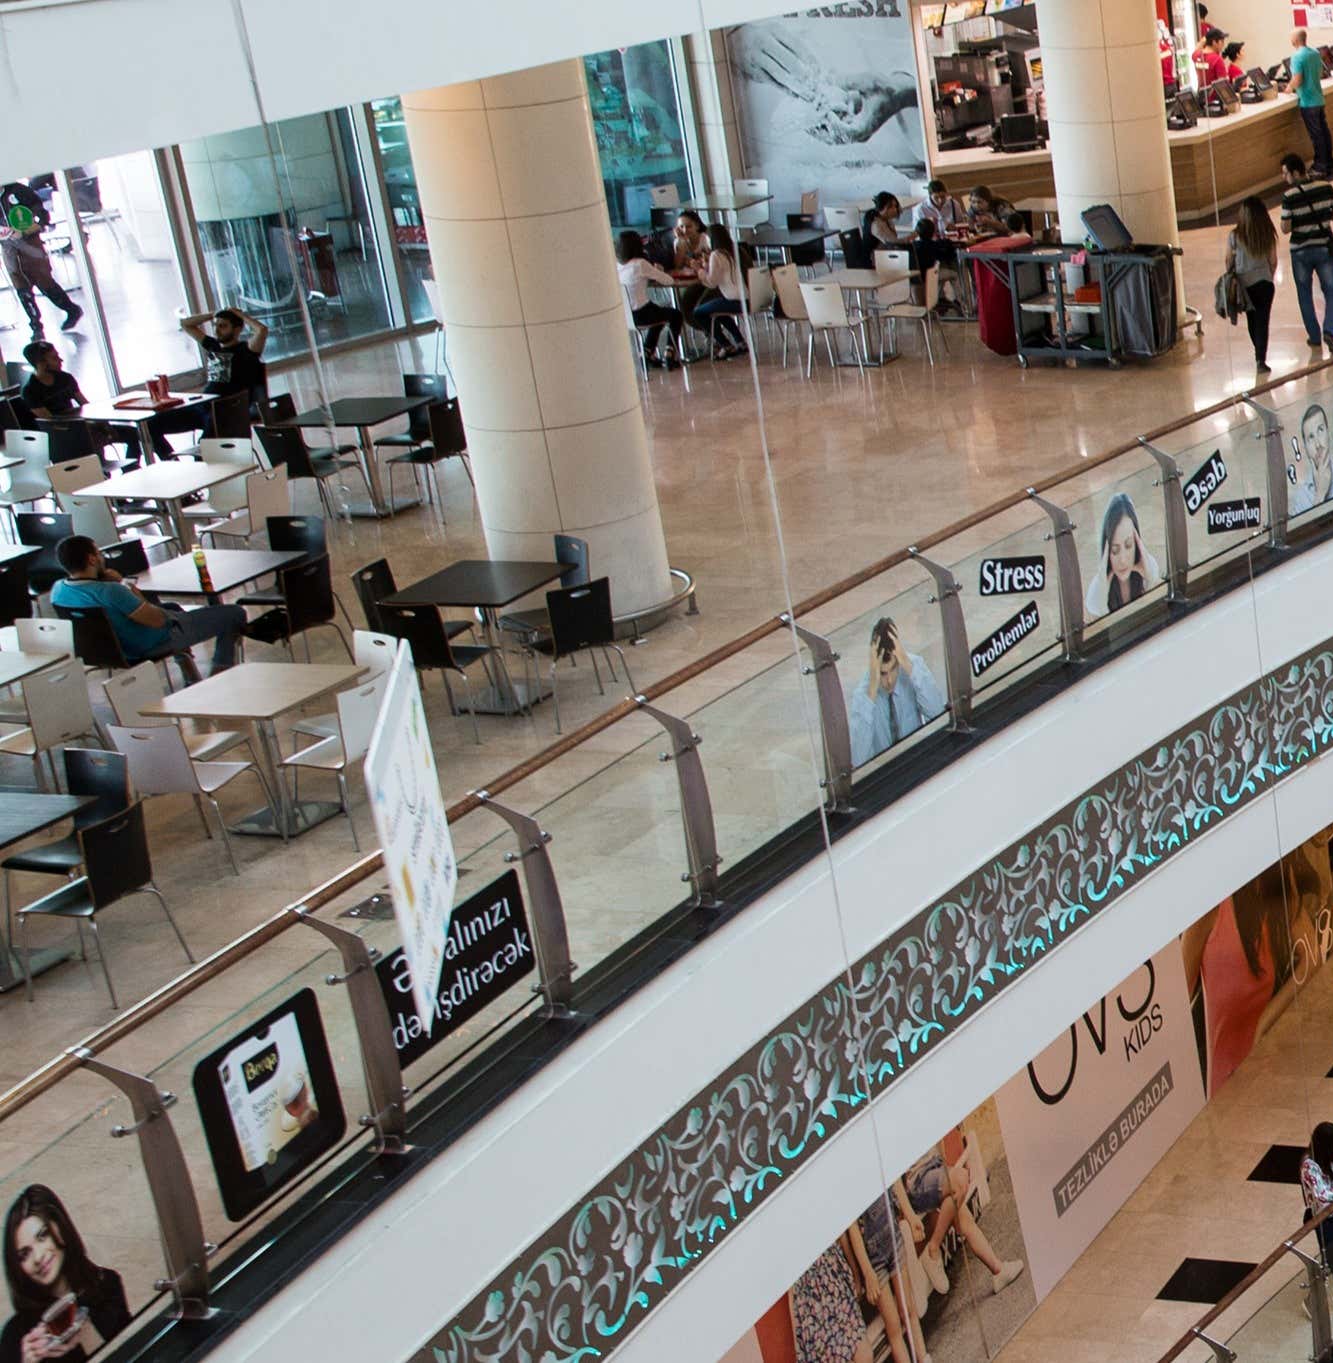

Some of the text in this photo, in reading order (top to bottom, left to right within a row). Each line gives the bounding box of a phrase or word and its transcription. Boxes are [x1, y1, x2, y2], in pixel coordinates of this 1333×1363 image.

[1184, 457, 1226, 511] Əsəb
[1208, 503, 1261, 529] Yorğunluq
[981, 560, 1044, 594] Stress
[972, 610, 1038, 674] Problemlər
[391, 897, 511, 994] Əalınızı
[1123, 1004, 1164, 1062] KIDS
[1058, 1075, 1170, 1208] TEZLİKLƏ BURADA
